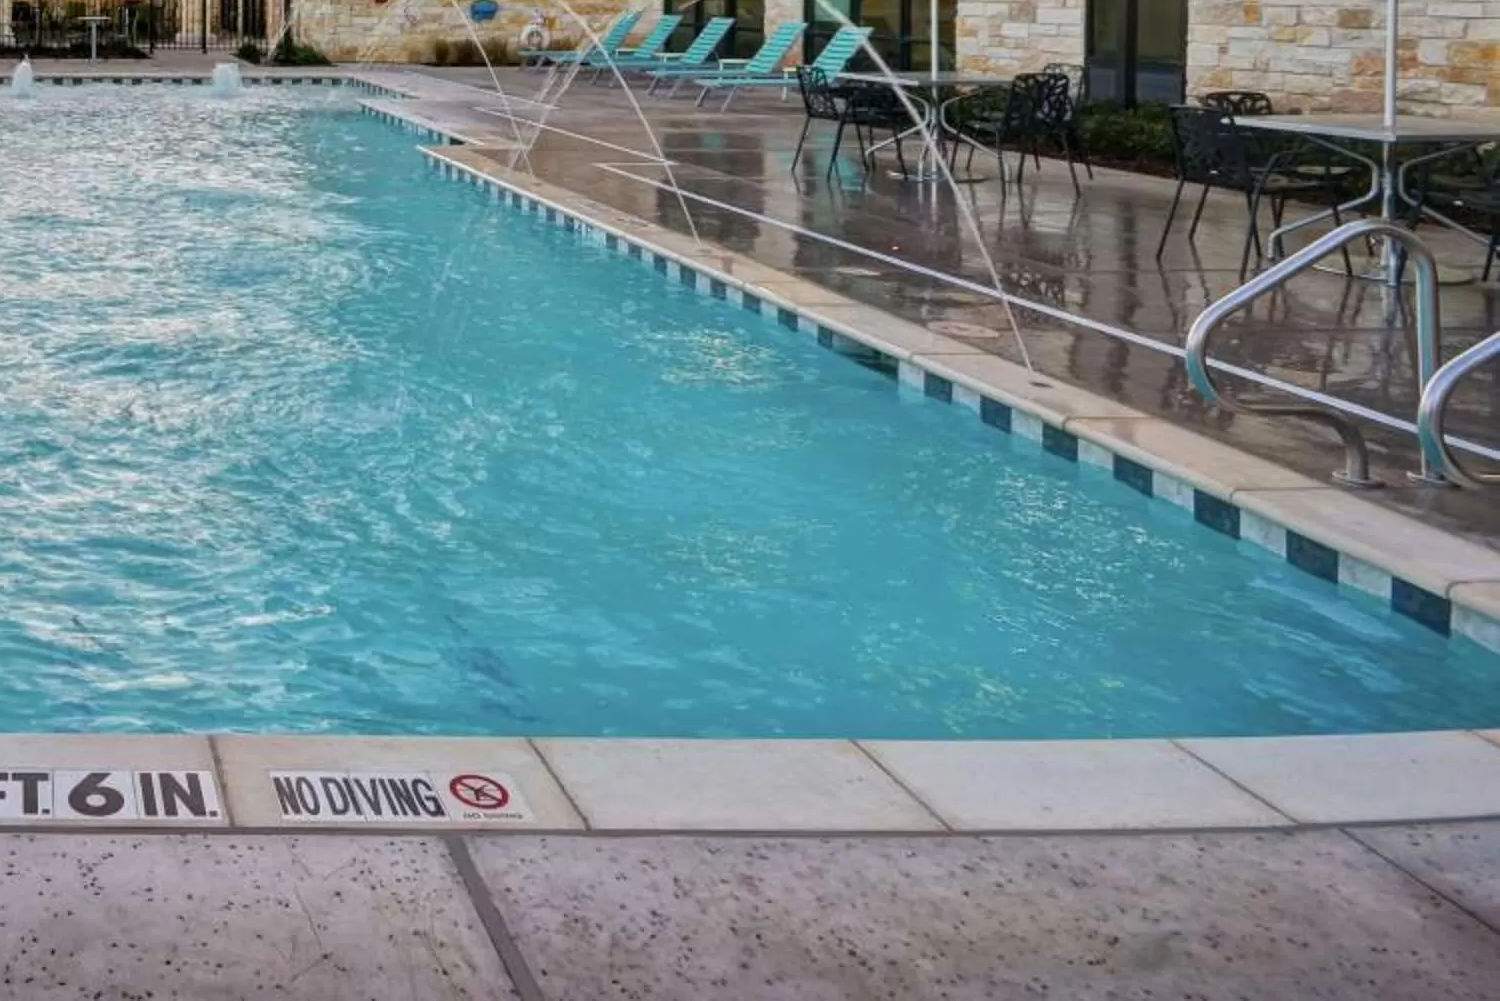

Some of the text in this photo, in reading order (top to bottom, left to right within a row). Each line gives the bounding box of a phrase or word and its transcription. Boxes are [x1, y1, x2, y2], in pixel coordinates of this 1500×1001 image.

[67, 772, 125, 817] 6
[138, 772, 220, 818] IN.
[272, 775, 446, 818] NO DIVING
